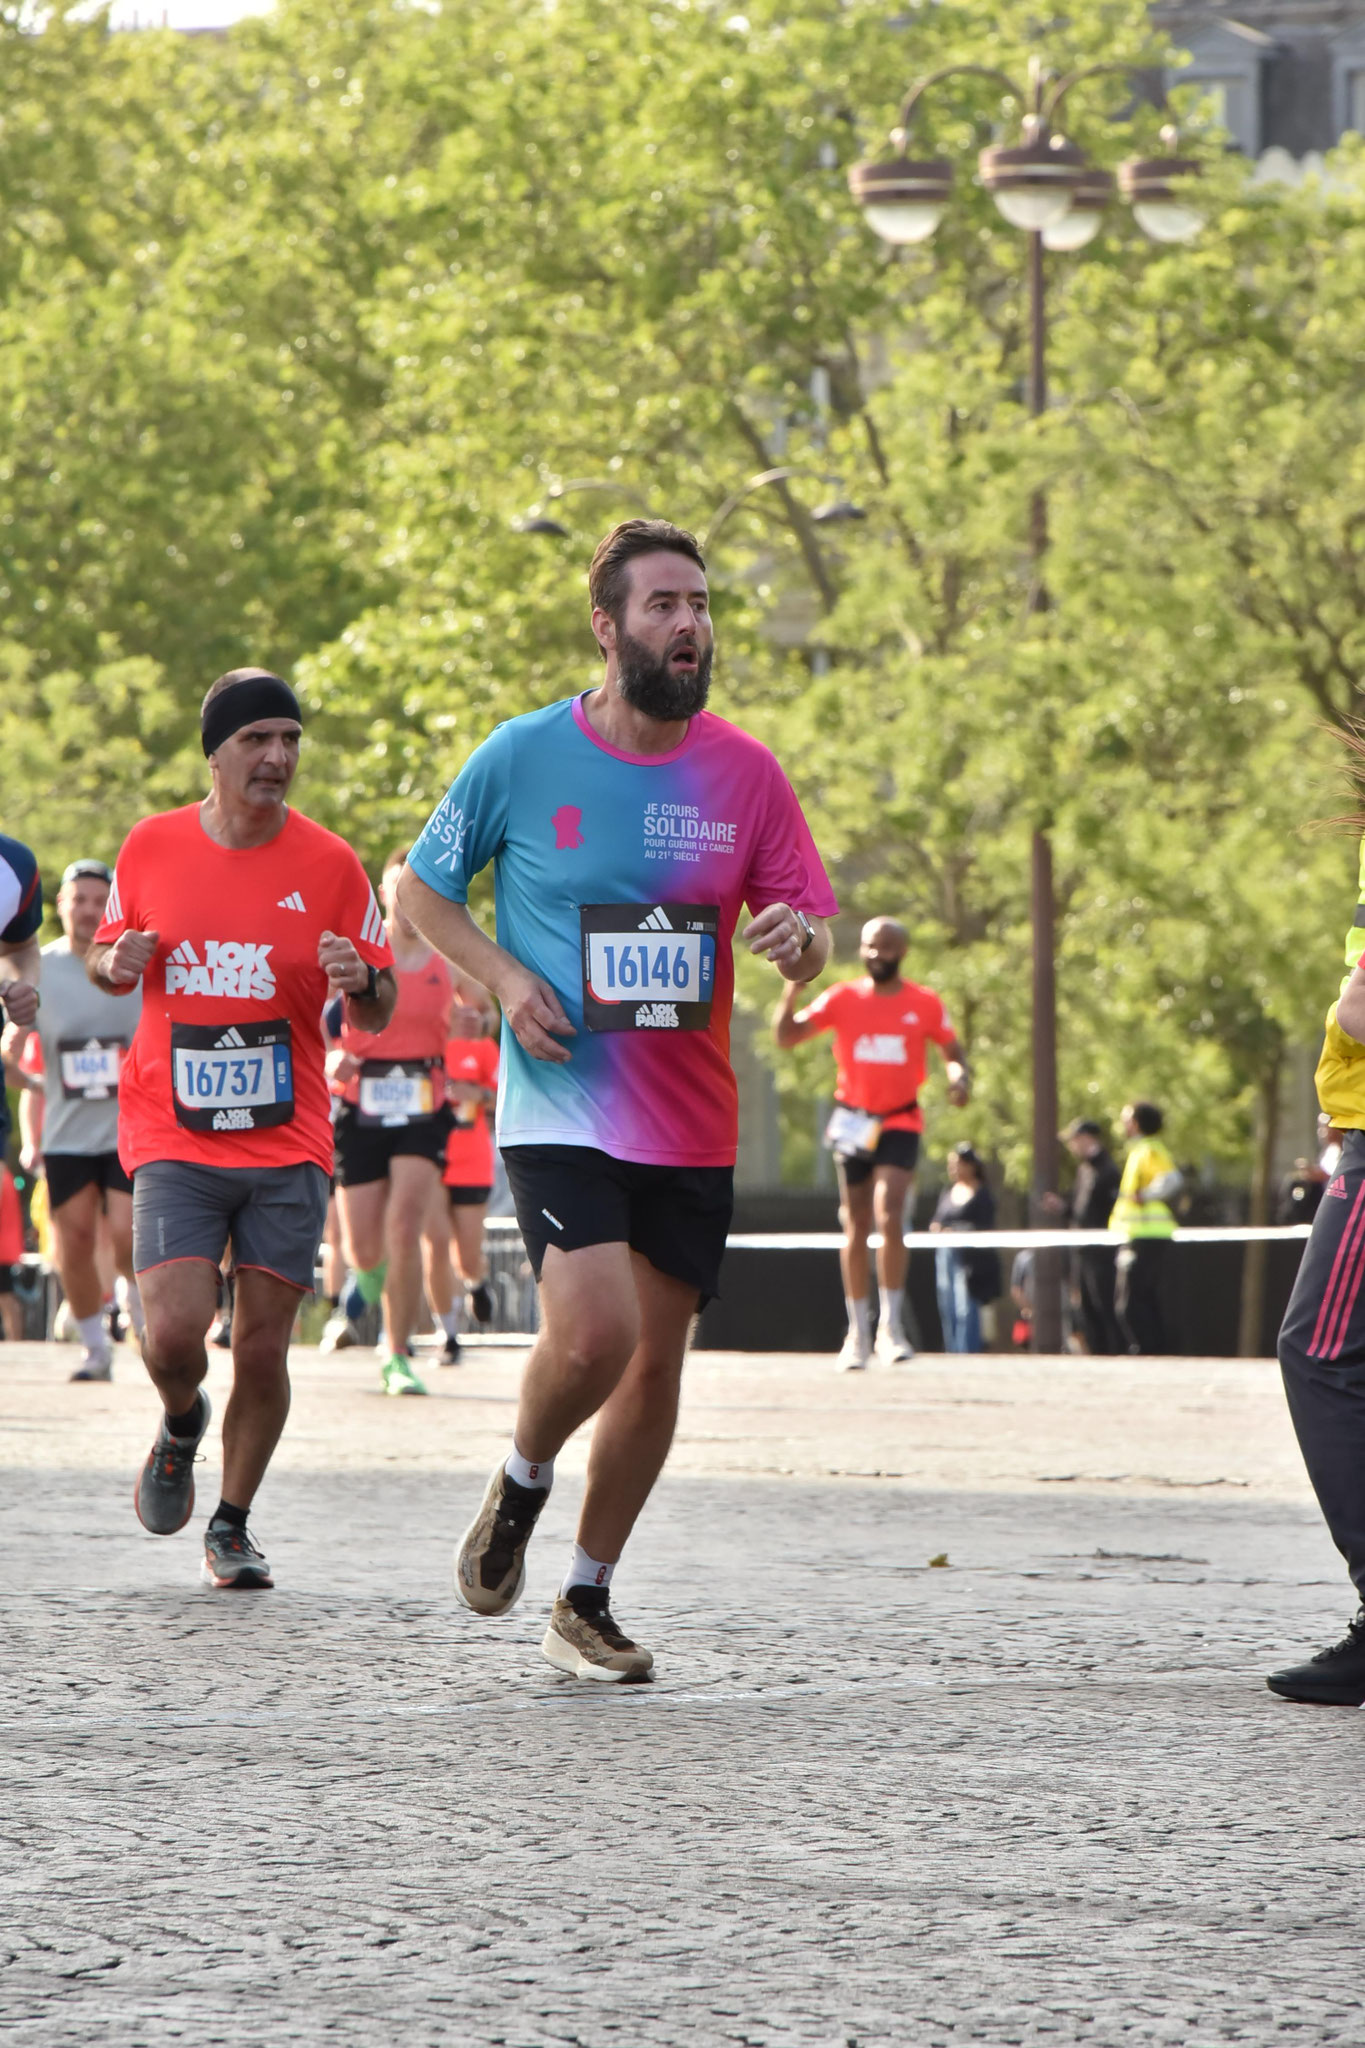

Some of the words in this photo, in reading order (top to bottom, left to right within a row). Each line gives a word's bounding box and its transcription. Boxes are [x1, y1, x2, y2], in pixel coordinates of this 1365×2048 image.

[643, 803, 658, 815] JE
[661, 803, 699, 818] COURS
[643, 816, 737, 843] SOLIDAIRE
[643, 838, 666, 848] POUR
[668, 839, 697, 850] GUÉRIR
[699, 842, 708, 851] LE
[709, 843, 735, 854] CANCER
[644, 850, 656, 859] AU
[686, 921, 691, 931] 7
[205, 940, 274, 970] 10K
[603, 946, 690, 989] 16146
[165, 966, 277, 1001] PARIS
[650, 1003, 678, 1019] 10K
[635, 1014, 679, 1028] PARIS
[184, 1058, 264, 1098] 16737
[212, 1117, 255, 1131] PARIS
